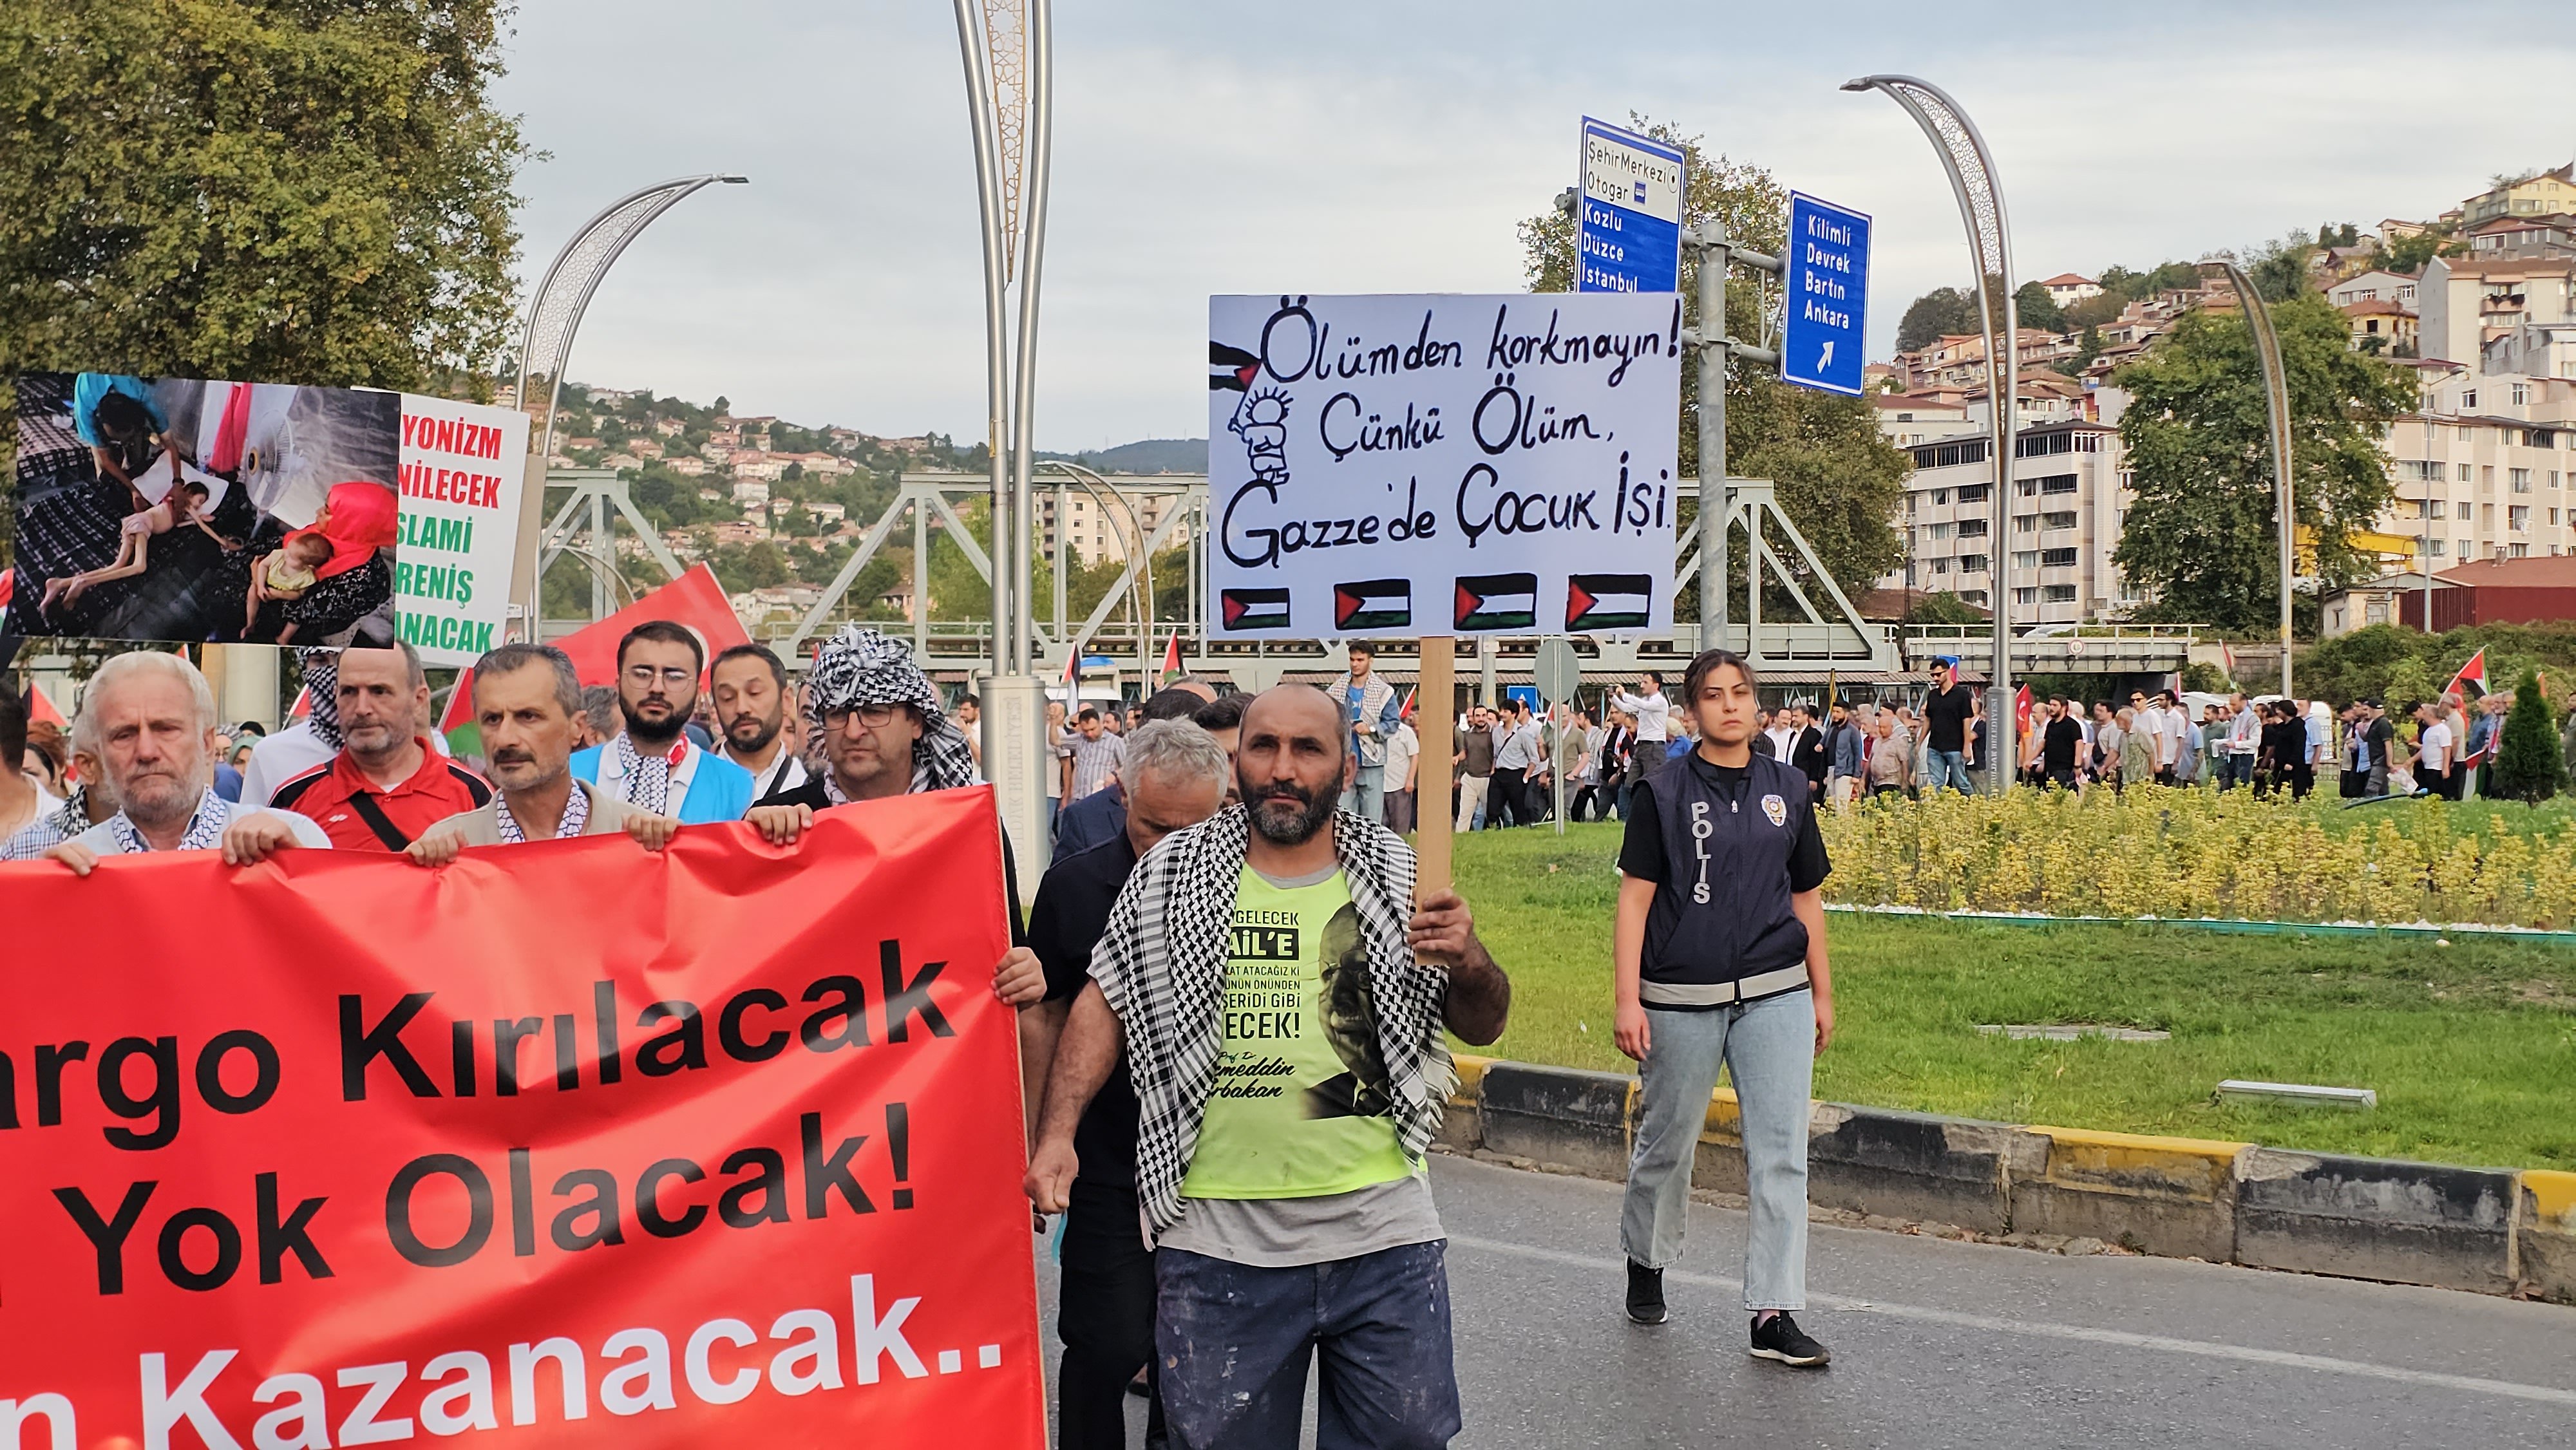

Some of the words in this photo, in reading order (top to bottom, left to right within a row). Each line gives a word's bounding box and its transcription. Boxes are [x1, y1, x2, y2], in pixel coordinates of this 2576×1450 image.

[1588, 142, 1620, 168] Şehir
[1621, 151, 1667, 184] Merkezi
[1587, 171, 1628, 202] Otogar
[1584, 202, 1622, 232] Kozlu
[1808, 214, 1851, 247] Kilimli
[1583, 232, 1624, 263] Düzce
[1806, 243, 1850, 274] Devrek
[1582, 262, 1638, 293] İstanbul
[1805, 272, 1845, 301] Bartın
[1804, 299, 1850, 330] Ankara
[1260, 295, 1461, 382] Ölümden
[1487, 299, 1680, 386] korkmayın!
[1320, 392, 1444, 462] Çünkü
[1472, 373, 1613, 455] Ölüm,
[402, 414, 502, 460] YONİZM
[397, 460, 502, 509] NİLECEK
[395, 561, 474, 609] RENİŞ
[1236, 910, 1299, 926] GELECEK
[1243, 965, 1288, 976] ATACAĞIZ
[1291, 966, 1299, 977] Kİ
[1226, 1012, 1300, 1039] ECEK!
[0, 1029, 281, 1151] rgo
[339, 939, 957, 1102] Kırılacak
[1209, 1078, 1283, 1098] rbakan
[52, 1171, 336, 1295] Yok
[386, 1102, 914, 1268] Olacak!
[140, 1274, 1001, 1450] Kazanacak..
